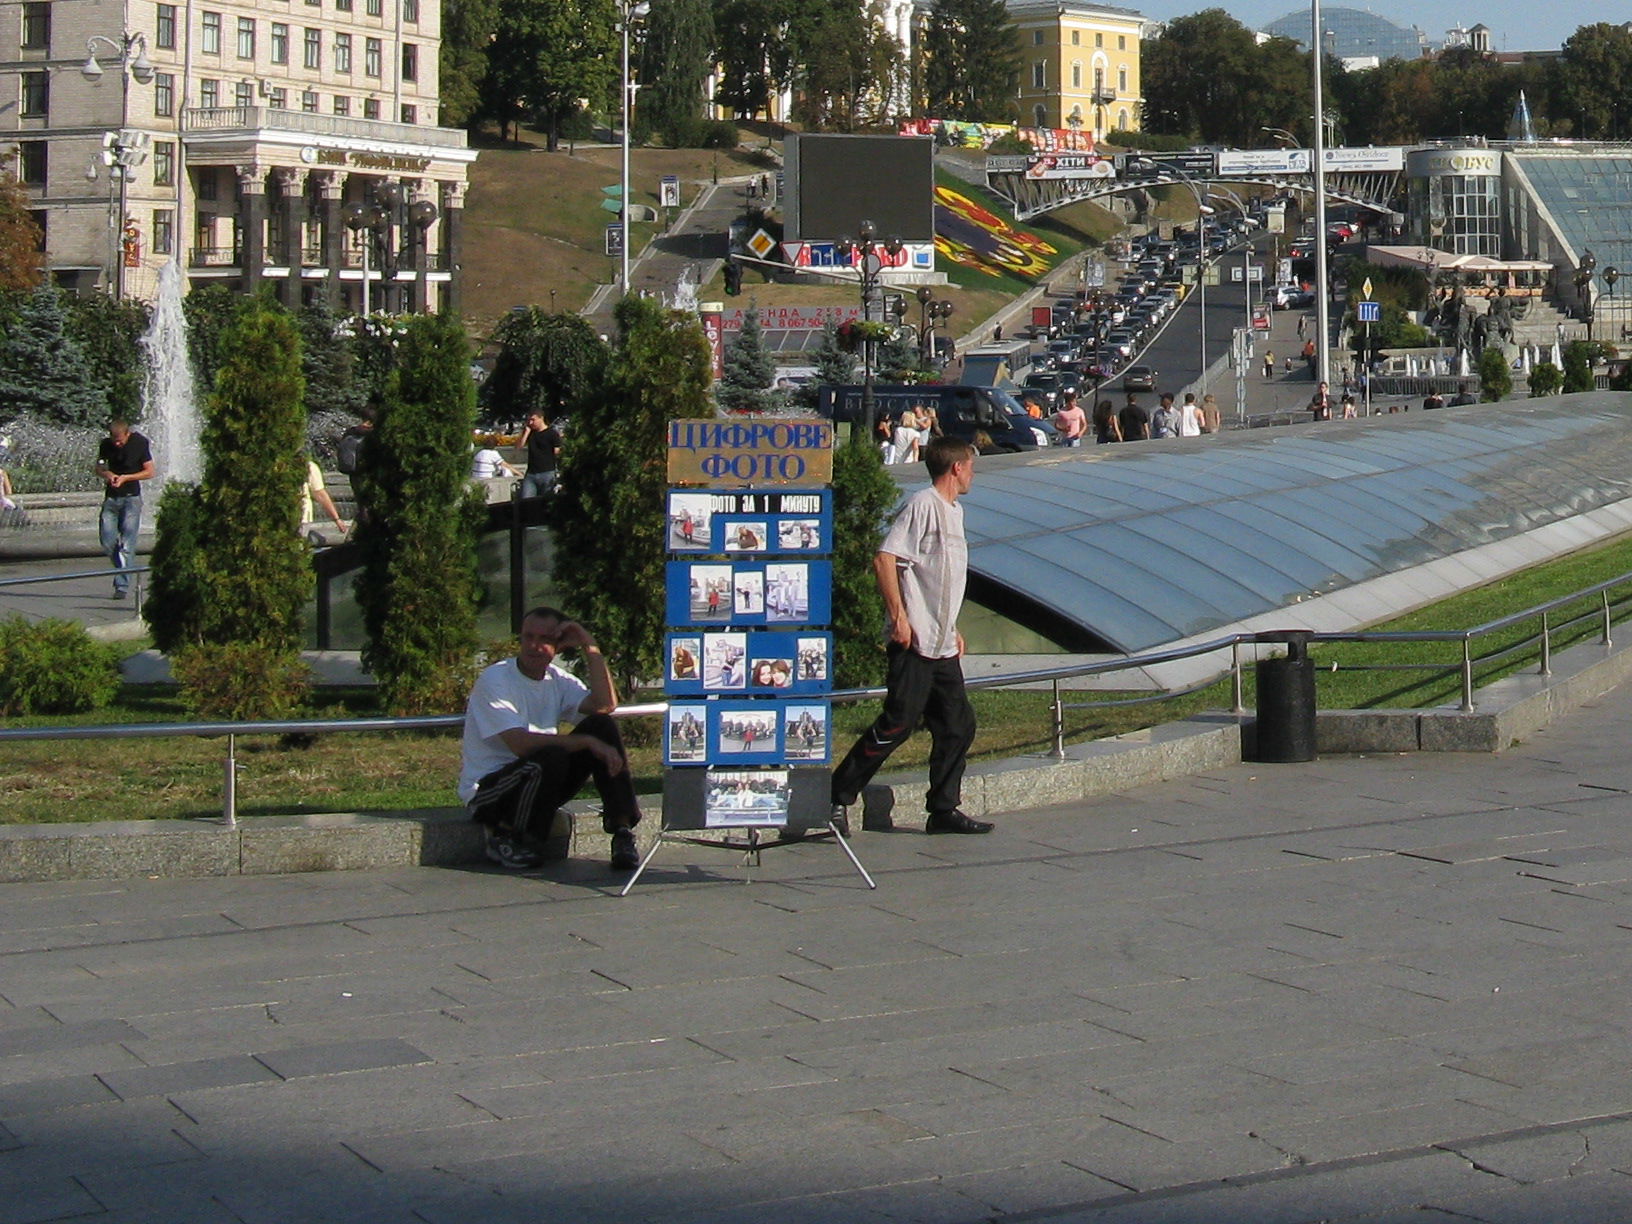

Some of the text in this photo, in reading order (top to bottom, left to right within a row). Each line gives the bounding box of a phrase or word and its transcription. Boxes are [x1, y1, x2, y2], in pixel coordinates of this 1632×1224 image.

[735, 308, 799, 318] АЕНДА
[671, 423, 832, 454] ЦИФРОВЕ
[701, 453, 806, 480] ФОТО
[710, 495, 820, 513] ФОТО ЗА 1 МИНУТУ
